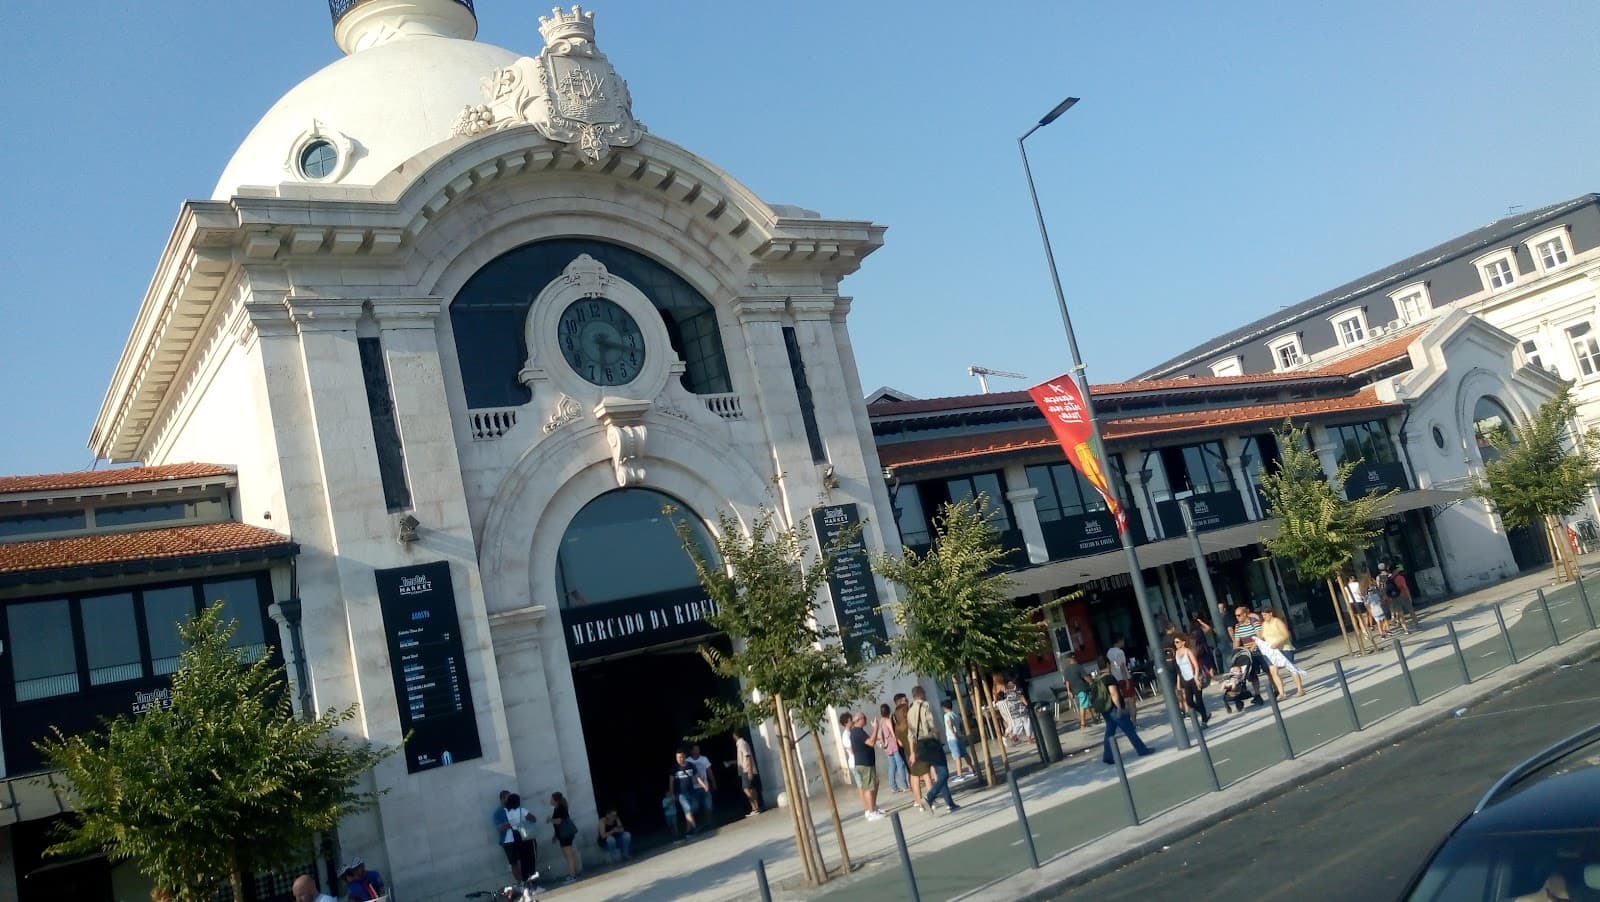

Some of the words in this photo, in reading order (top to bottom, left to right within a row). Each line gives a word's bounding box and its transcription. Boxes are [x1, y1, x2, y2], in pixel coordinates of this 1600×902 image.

[576, 308, 586, 322] 11
[589, 304, 601, 317] 12
[607, 308, 614, 322] 1
[566, 320, 578, 335] 10
[566, 337, 574, 351] 9
[628, 335, 635, 347] 3
[574, 355, 581, 367] 8
[630, 352, 637, 366] 4
[588, 365, 595, 380] 7
[606, 368, 613, 381] 6
[620, 363, 627, 377] 5
[824, 516, 848, 524] MARKET
[399, 582, 433, 593] MARKET
[572, 613, 645, 645] MERCADO
[649, 607, 670, 630] DA
[674, 598, 722, 625] RIBEI
